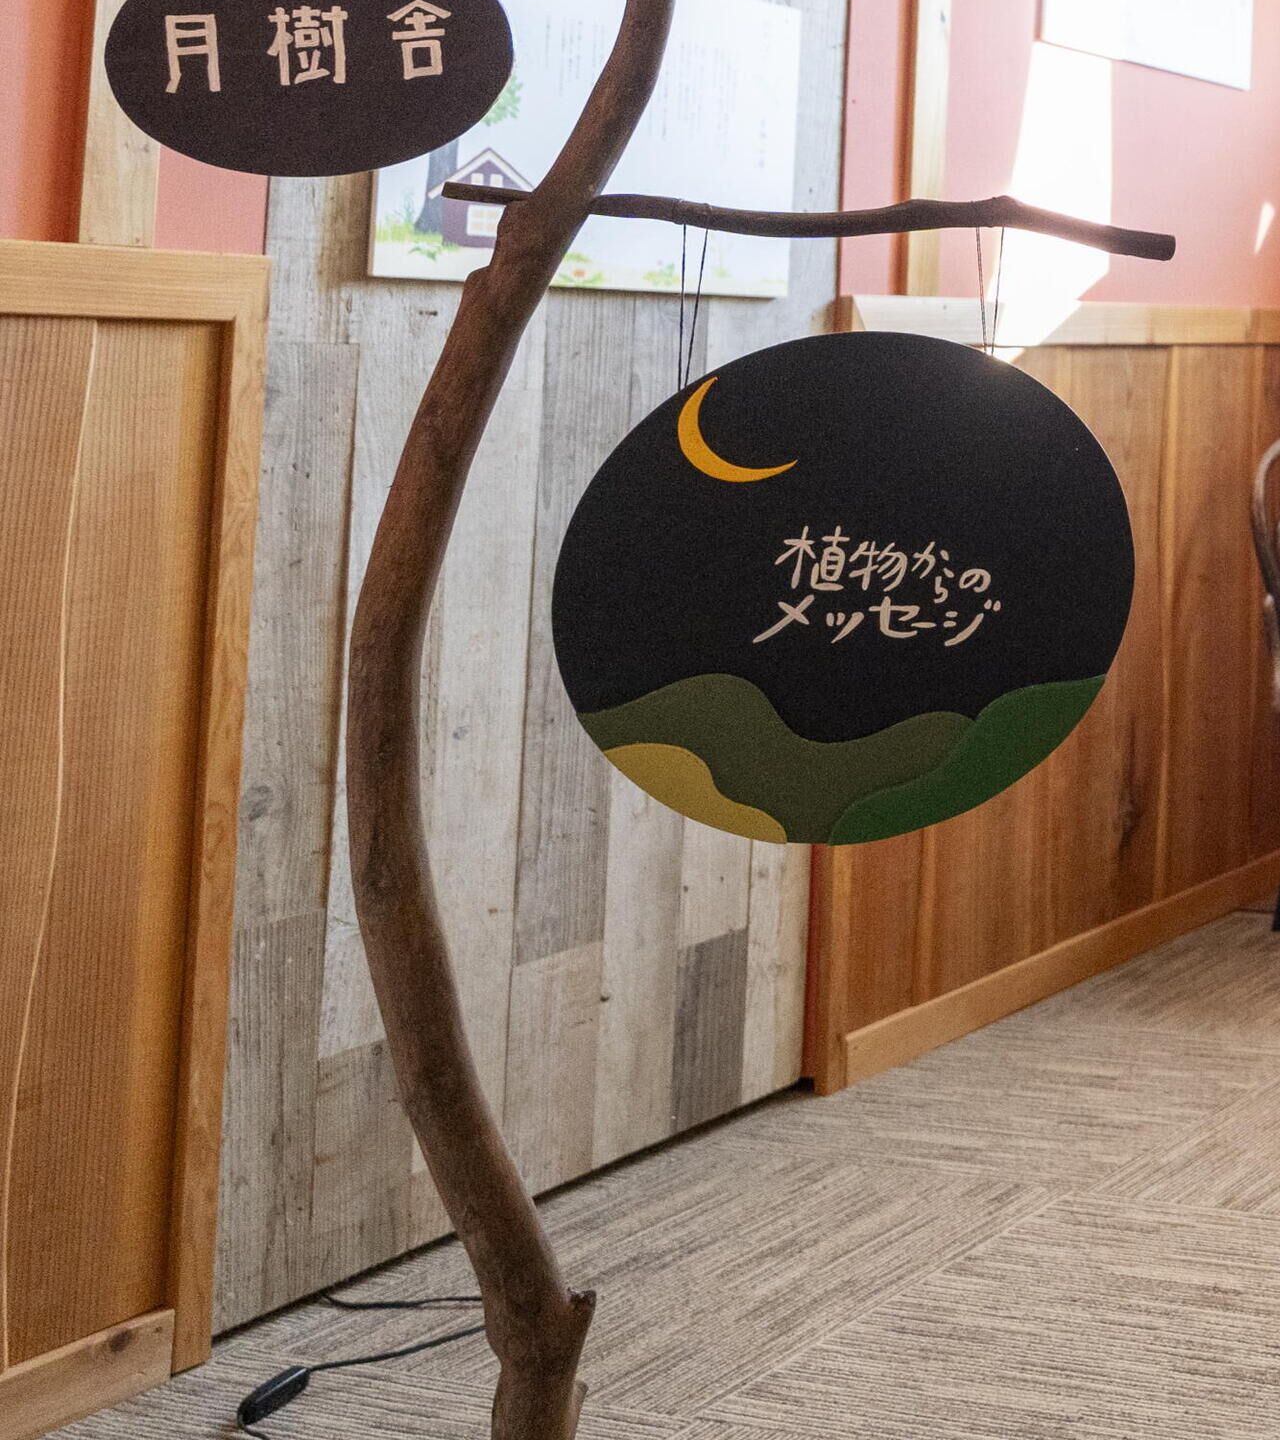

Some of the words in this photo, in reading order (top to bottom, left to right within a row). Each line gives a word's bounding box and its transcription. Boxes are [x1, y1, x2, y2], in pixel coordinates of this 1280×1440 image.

[774, 525, 992, 604] 植物からの
[752, 596, 1002, 647] メッセージ
